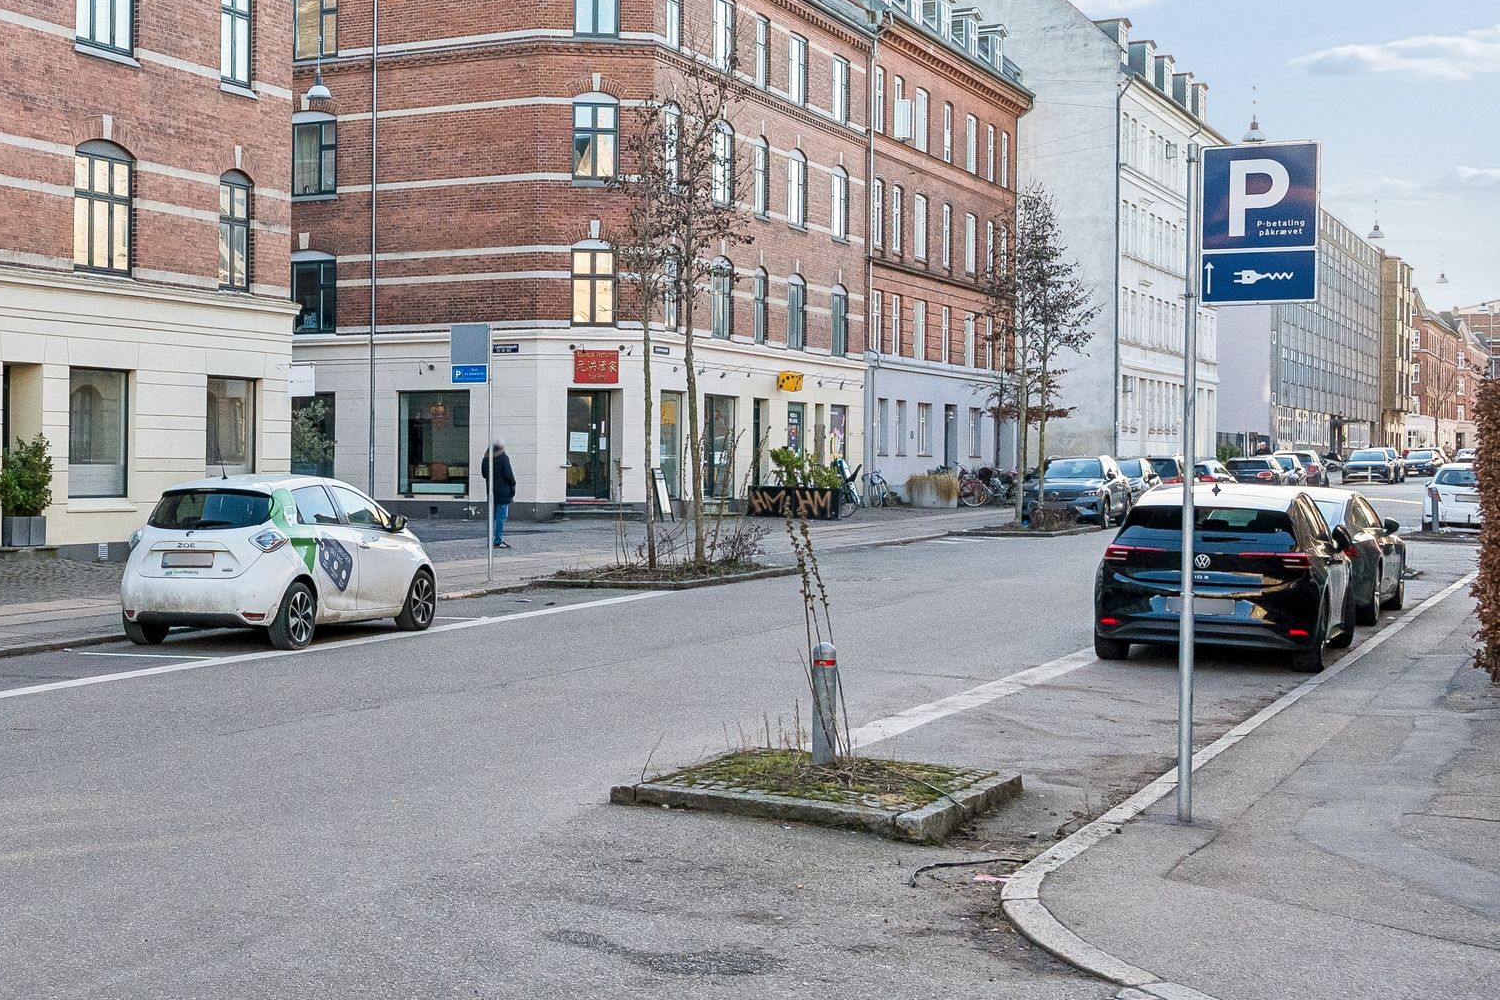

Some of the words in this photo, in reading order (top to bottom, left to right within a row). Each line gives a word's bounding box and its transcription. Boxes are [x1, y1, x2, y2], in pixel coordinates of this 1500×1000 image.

[1228, 158, 1290, 237] P
[1257, 219, 1305, 228] P-betaling
[1259, 228, 1303, 236] påkrævet
[455, 370, 461, 379] P
